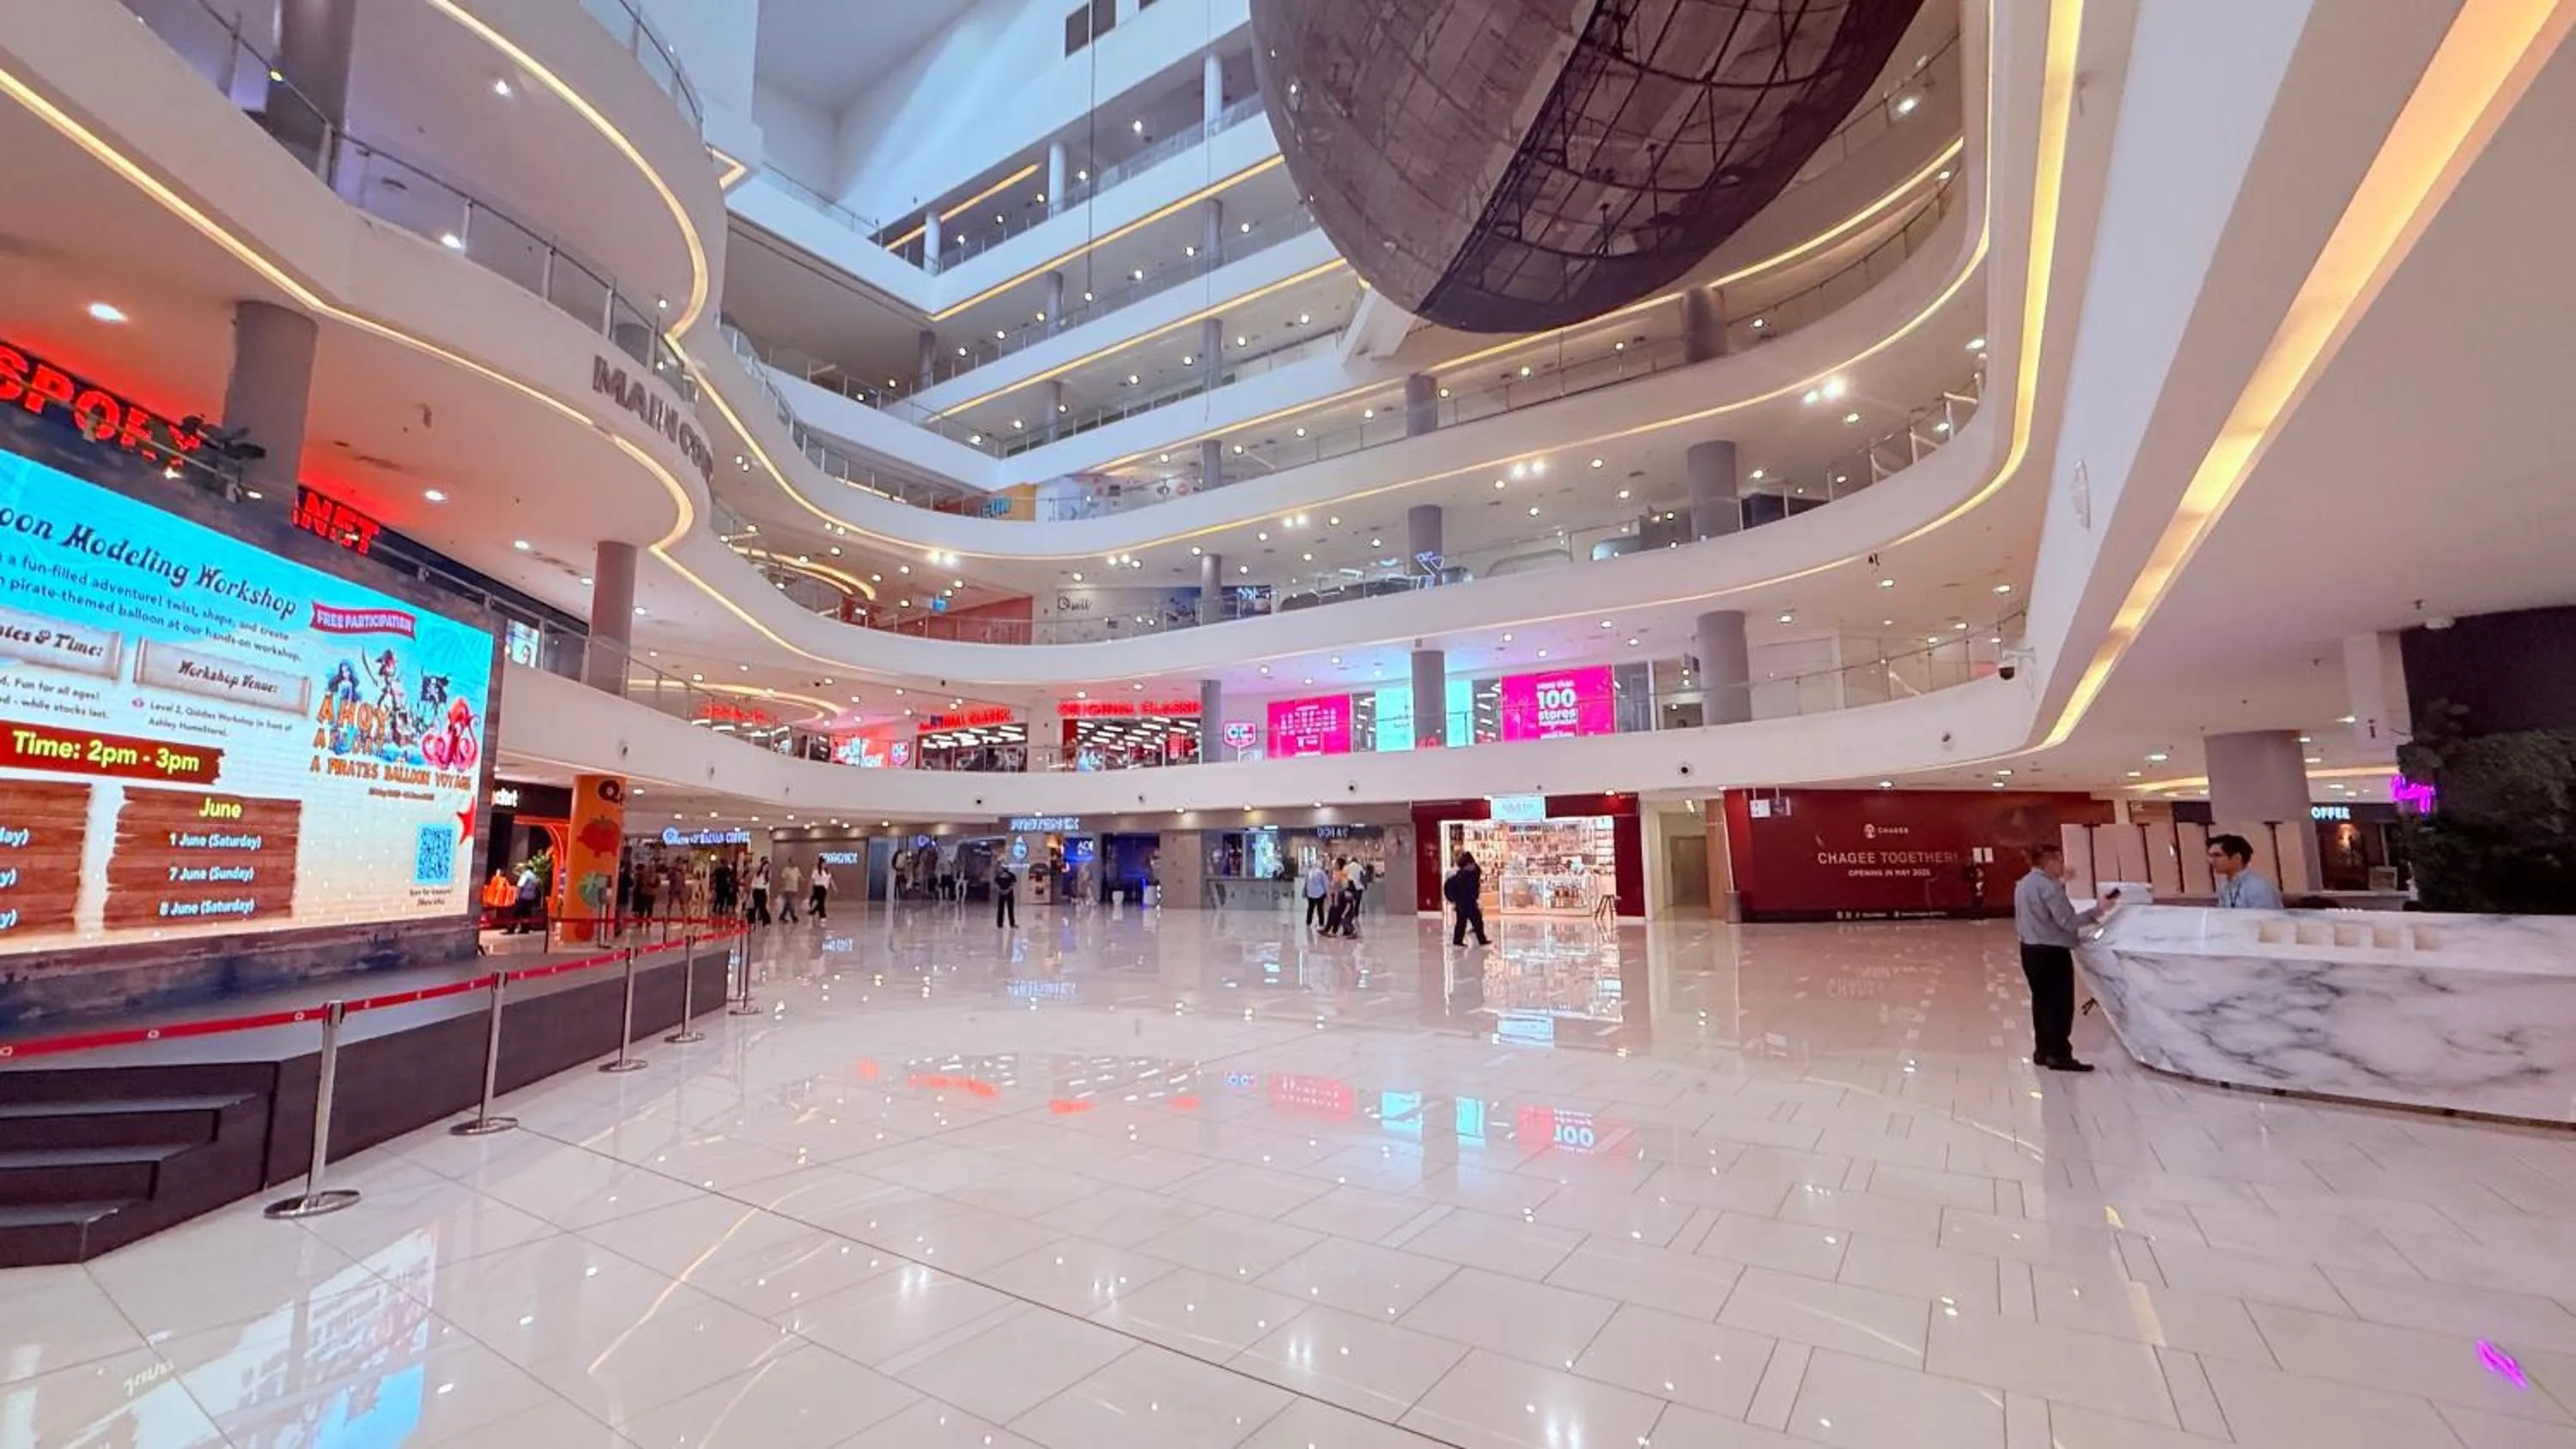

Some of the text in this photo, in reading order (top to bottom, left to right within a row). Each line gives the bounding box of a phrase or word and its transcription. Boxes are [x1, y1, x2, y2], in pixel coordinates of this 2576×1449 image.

[592, 354, 679, 443] MAIN
[293, 491, 380, 555] NET
[22, 554, 88, 586] fun-filled
[59, 522, 189, 588] Modeling
[195, 562, 297, 621] Workshop
[9, 576, 114, 613] pirate-themed
[118, 601, 165, 628] balloon
[167, 618, 179, 631] at
[183, 623, 203, 635] our
[205, 625, 252, 648] hands-on
[317, 610, 344, 627] FREE
[53, 633, 104, 657] Time:
[178, 659, 240, 688] Workshop
[1536, 688, 1577, 710] 100
[1538, 708, 1578, 721] stores
[13, 730, 82, 759] Time:
[87, 740, 137, 767] 2pm
[155, 748, 200, 774] 3pm
[198, 797, 242, 818] June
[169, 833, 262, 850] 1 June (Saturday)
[1817, 851, 1959, 865] CHAGEE TOGETHER!
[179, 867, 207, 880] June
[209, 866, 254, 882] (Sunday)
[1848, 869, 1883, 877] OPENING
[1885, 869, 1893, 877] IN
[170, 901, 198, 916] June
